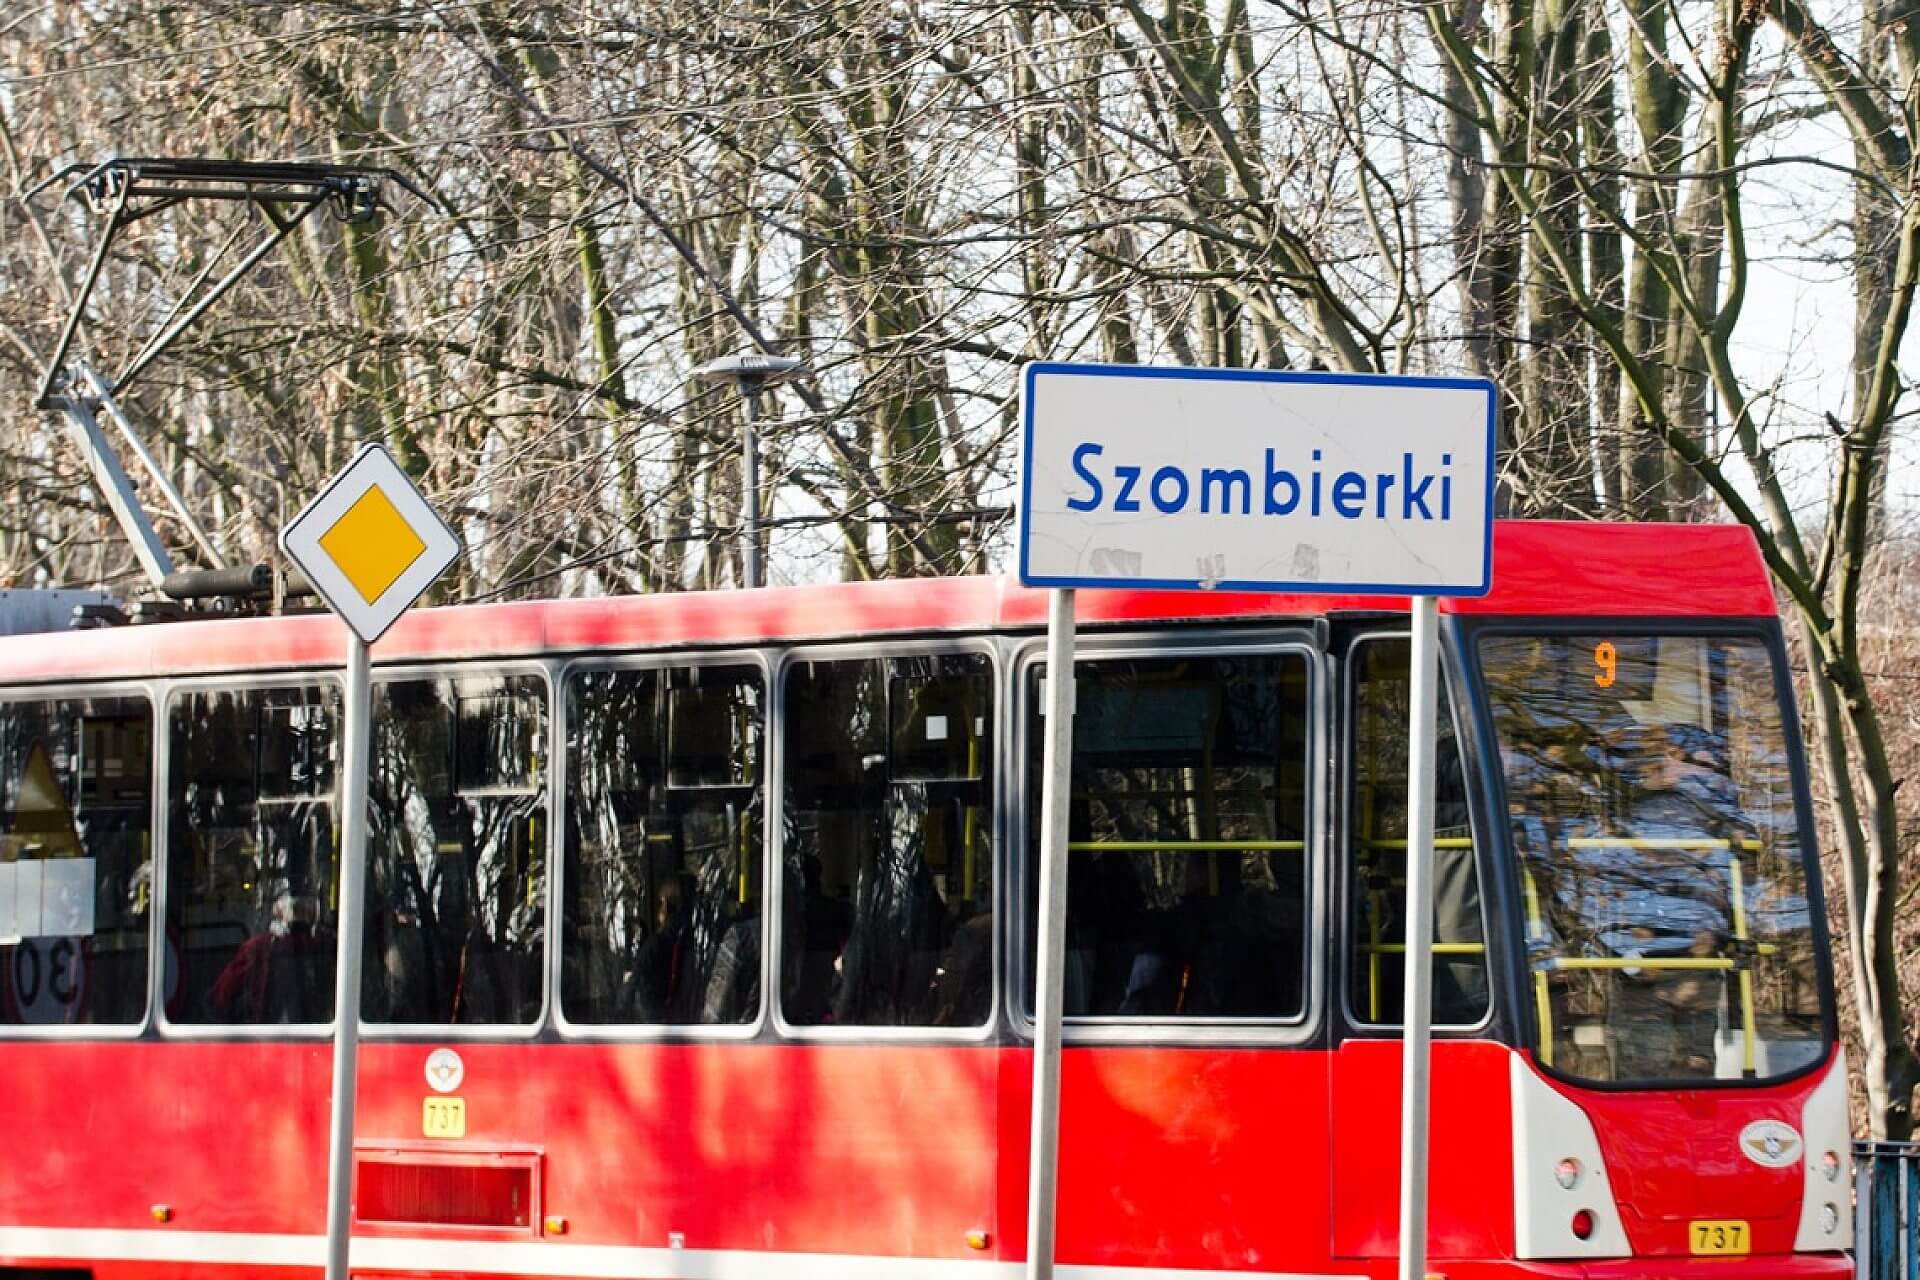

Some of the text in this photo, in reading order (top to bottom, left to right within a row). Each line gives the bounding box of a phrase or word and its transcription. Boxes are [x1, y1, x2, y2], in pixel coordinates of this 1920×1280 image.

[1066, 442, 1451, 520] Szombierki
[1594, 641, 1616, 688] 9
[427, 1104, 460, 1129] 737
[1696, 1226, 1743, 1249] 737
